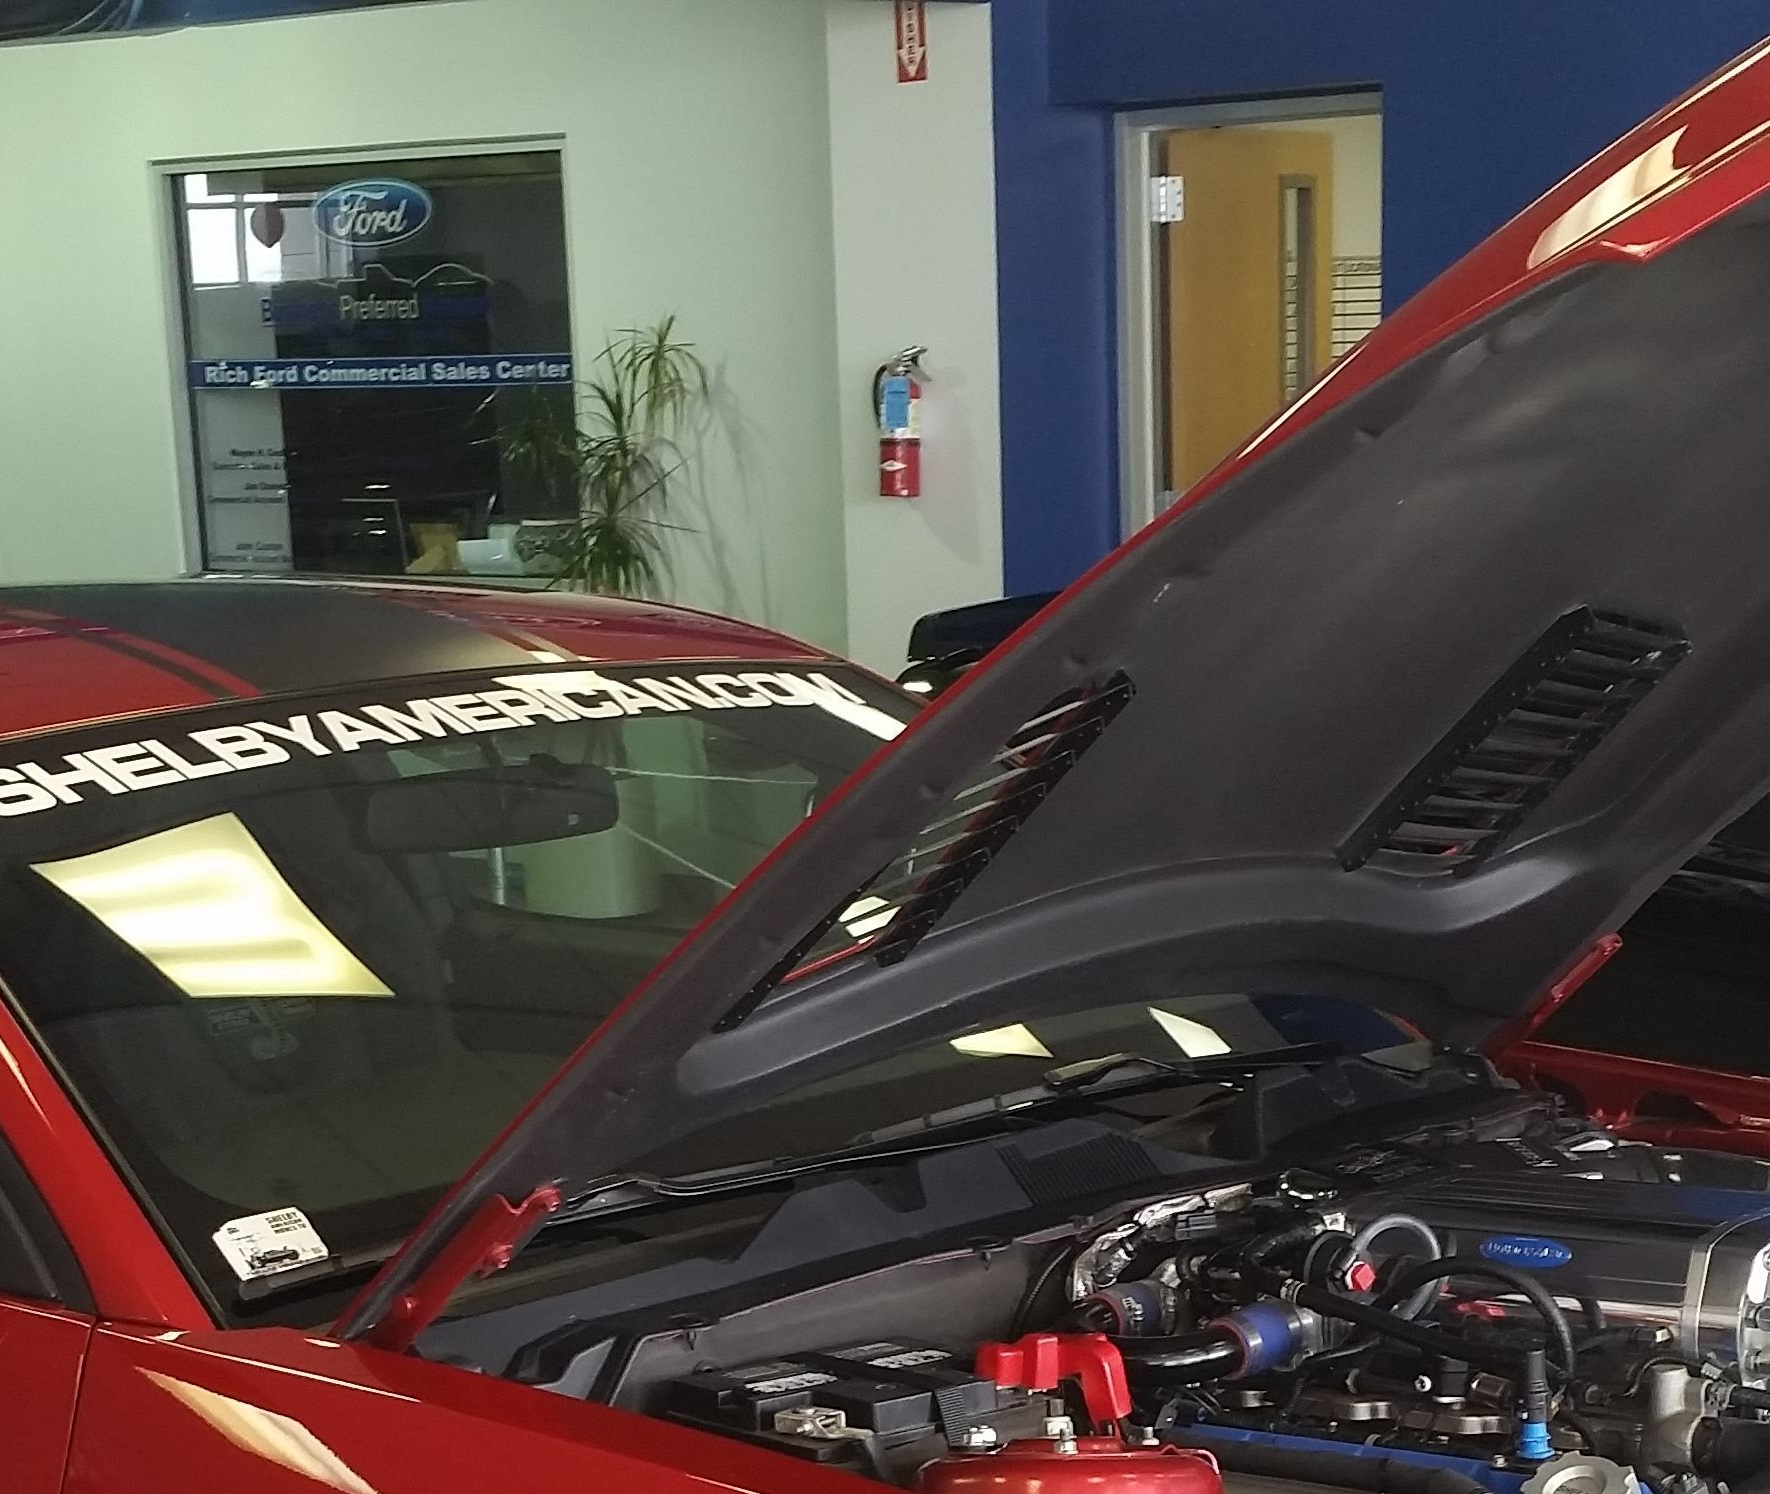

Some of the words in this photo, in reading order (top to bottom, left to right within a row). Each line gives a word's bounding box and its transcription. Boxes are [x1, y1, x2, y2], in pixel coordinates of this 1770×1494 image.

[332, 188, 410, 237] Ford
[338, 292, 420, 321] Preferred
[204, 362, 249, 384] Rich
[253, 364, 299, 385] Ford
[302, 362, 427, 383] Commercial
[431, 360, 491, 382] Sales
[494, 359, 571, 380] Center
